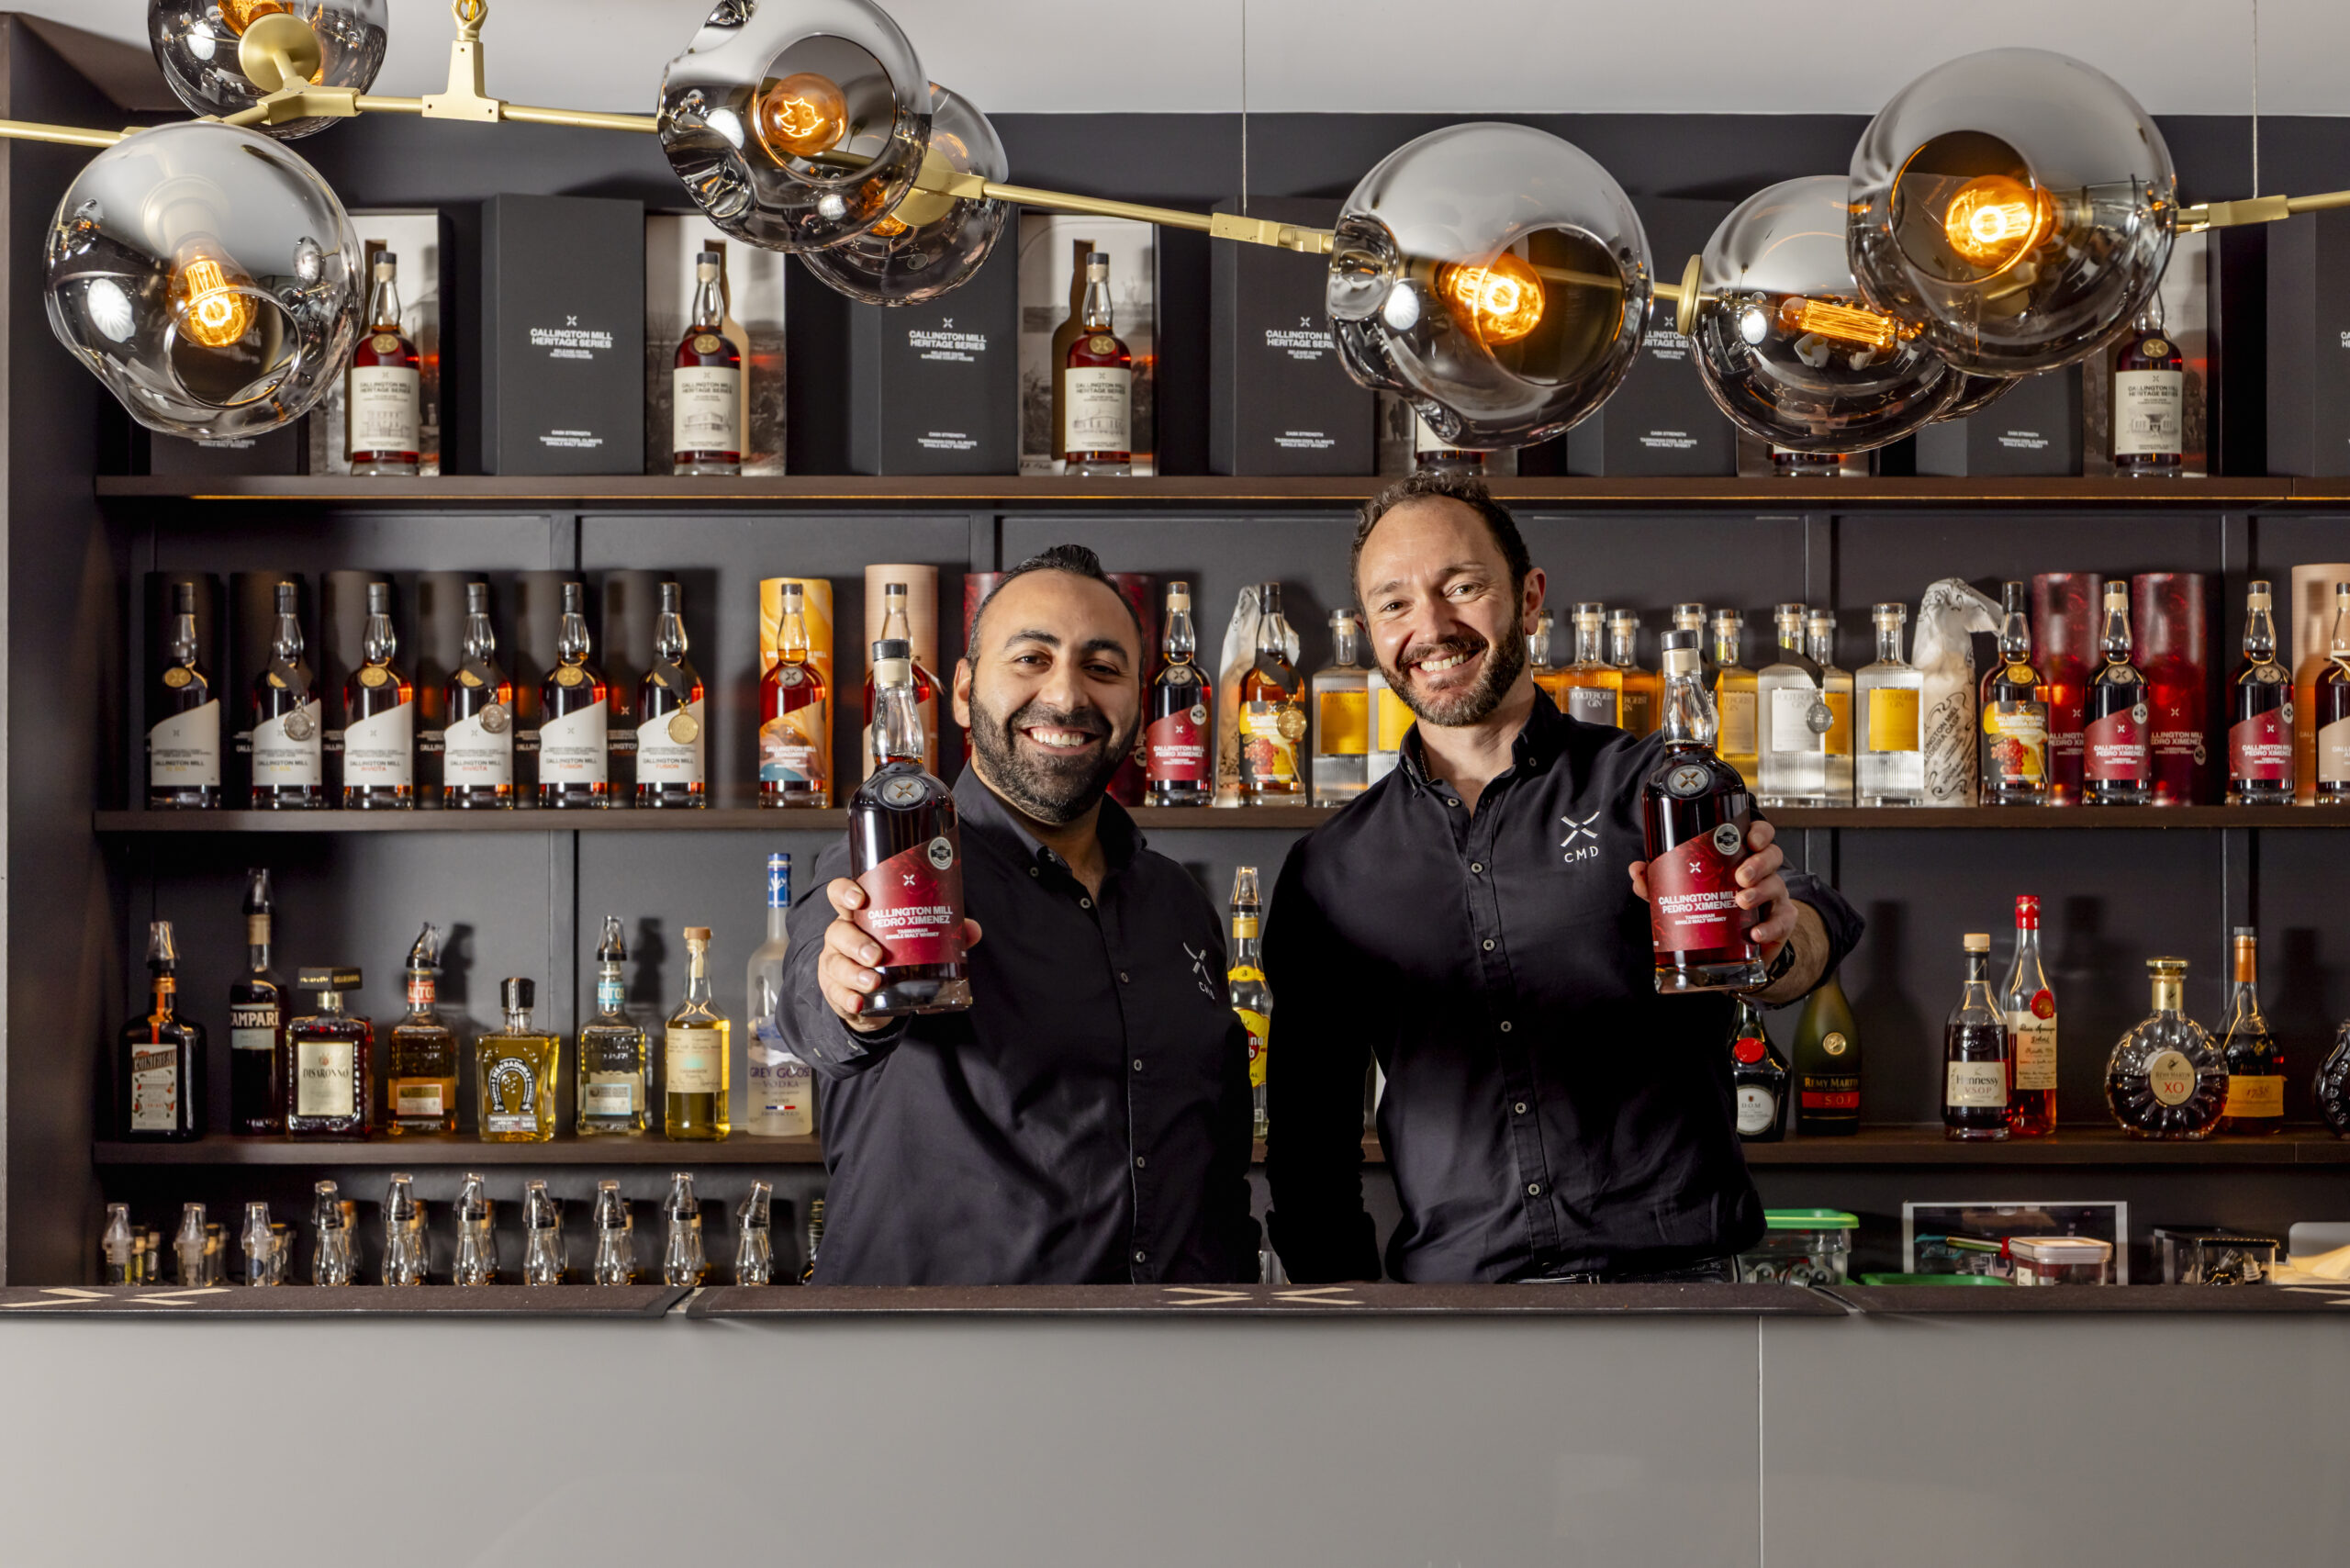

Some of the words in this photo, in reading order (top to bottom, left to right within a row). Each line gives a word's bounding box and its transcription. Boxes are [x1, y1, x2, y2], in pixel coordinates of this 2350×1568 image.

[531, 328, 589, 339] CALLINGTON
[590, 330, 613, 341] MILL
[909, 330, 965, 342] CALLINGTON
[966, 333, 987, 342] MILL
[1265, 330, 1323, 340] CALLINGTON
[532, 337, 578, 347] HERITAGE
[579, 339, 612, 349] SERIES
[910, 339, 954, 349] HERITAGE
[955, 341, 986, 351] SERIES
[1267, 339, 1311, 348] HERITAGE
[1312, 340, 1335, 349] SERI
[1642, 339, 1674, 348] RITAGE
[1571, 690, 1616, 700] POLTERGEIST
[1587, 700, 1603, 708] GIN
[1945, 706, 1960, 723] MILL
[1946, 714, 1961, 734] CASK
[2048, 732, 2083, 740] ALLINGT
[1153, 745, 1193, 753] CALLINGTON
[1564, 846, 1599, 863] CMD
[1658, 891, 1718, 905] CALLINGTON
[1719, 890, 1739, 900] MIL
[867, 906, 932, 920] CALLINGTON
[933, 905, 953, 915] MILL
[1662, 902, 1693, 914] PEDRO
[1695, 900, 1739, 912] XIMENEZ
[872, 916, 906, 928] PEDRO
[907, 915, 950, 925] XIMENEZ
[230, 1011, 280, 1027] AMPARI
[303, 1068, 349, 1079] DISARONNO
[749, 1067, 771, 1078] GREY
[763, 1080, 799, 1088] VODKA
[2164, 1081, 2185, 1094] XO
